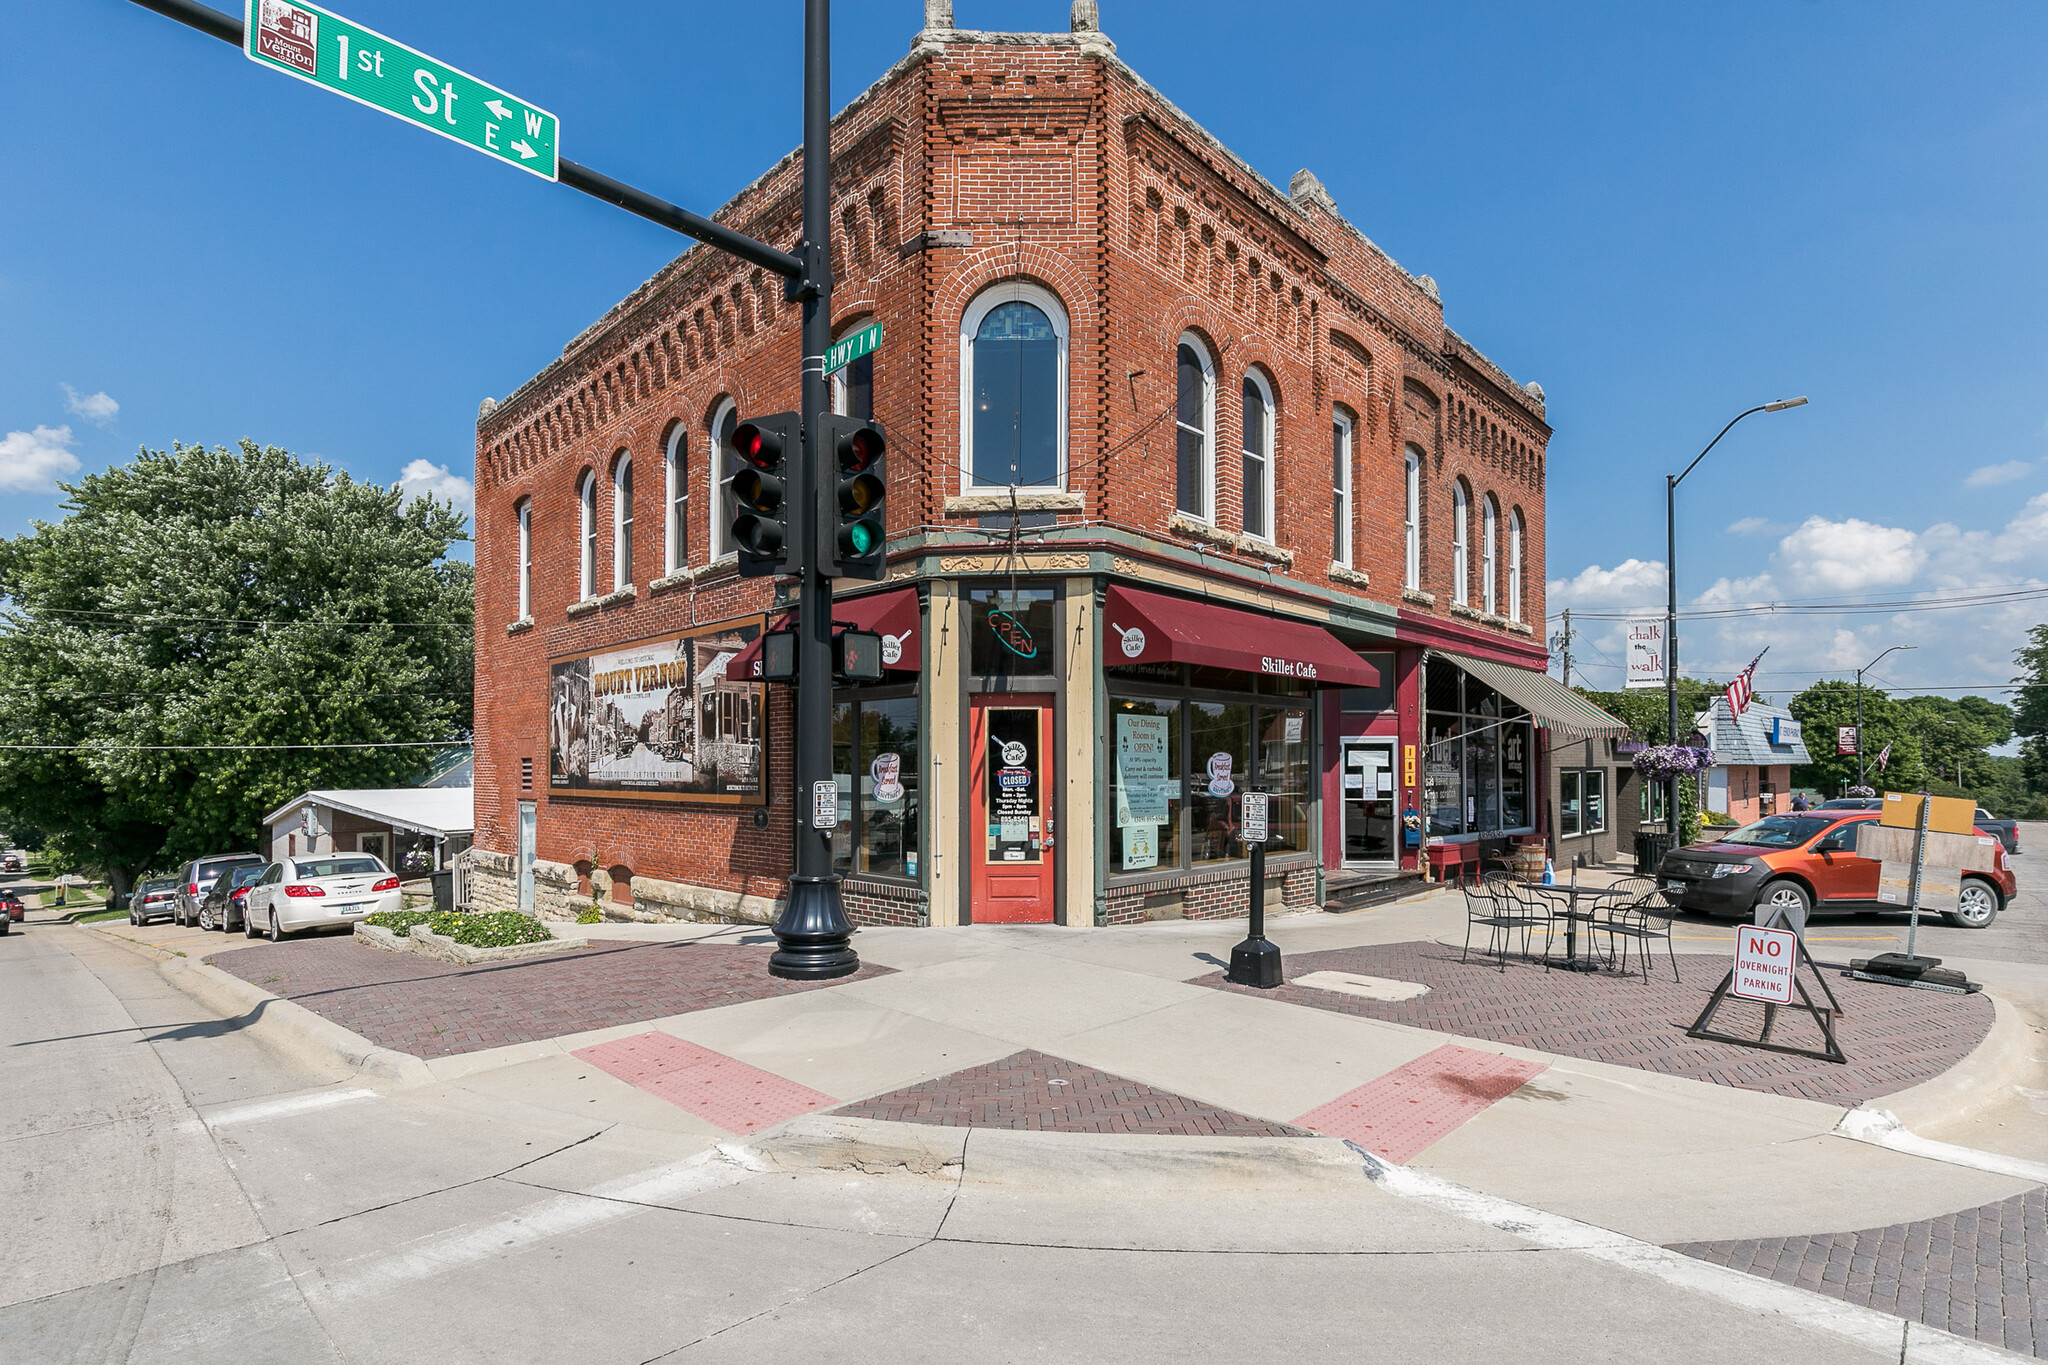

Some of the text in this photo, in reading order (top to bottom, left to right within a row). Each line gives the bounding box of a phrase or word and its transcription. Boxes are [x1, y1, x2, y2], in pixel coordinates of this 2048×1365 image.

[262, 36, 313, 67] Vernon
[275, 37, 301, 53] Mount
[278, 54, 296, 64] IOWA
[336, 35, 385, 81] 1st
[411, 68, 458, 125] St
[523, 110, 543, 139] W
[485, 122, 500, 151] E
[830, 328, 877, 369] HWY 1 N
[988, 614, 1033, 652] OPEN
[1123, 634, 1143, 644] Skillet
[1629, 625, 1661, 640] chalk
[882, 650, 898, 658] Cafe
[883, 641, 900, 651] killet
[1126, 643, 1141, 651] Cafe
[1261, 656, 1317, 678] Skillet Cafe
[1631, 655, 1664, 672] walk
[594, 660, 687, 698] MOUNT VERNON
[1127, 718, 1160, 730] Our Dining
[1132, 731, 1155, 740] Room is
[1004, 743, 1025, 754] Skillet
[1133, 743, 1154, 751] OPEN!
[1432, 727, 1451, 761] fuel
[1507, 733, 1522, 761] art
[1005, 753, 1022, 761] Cafe
[1002, 776, 1027, 785] CLOSED
[1749, 937, 1781, 957] NO
[1740, 960, 1789, 976] OVERNIGHT
[1743, 977, 1782, 993] PARKING
